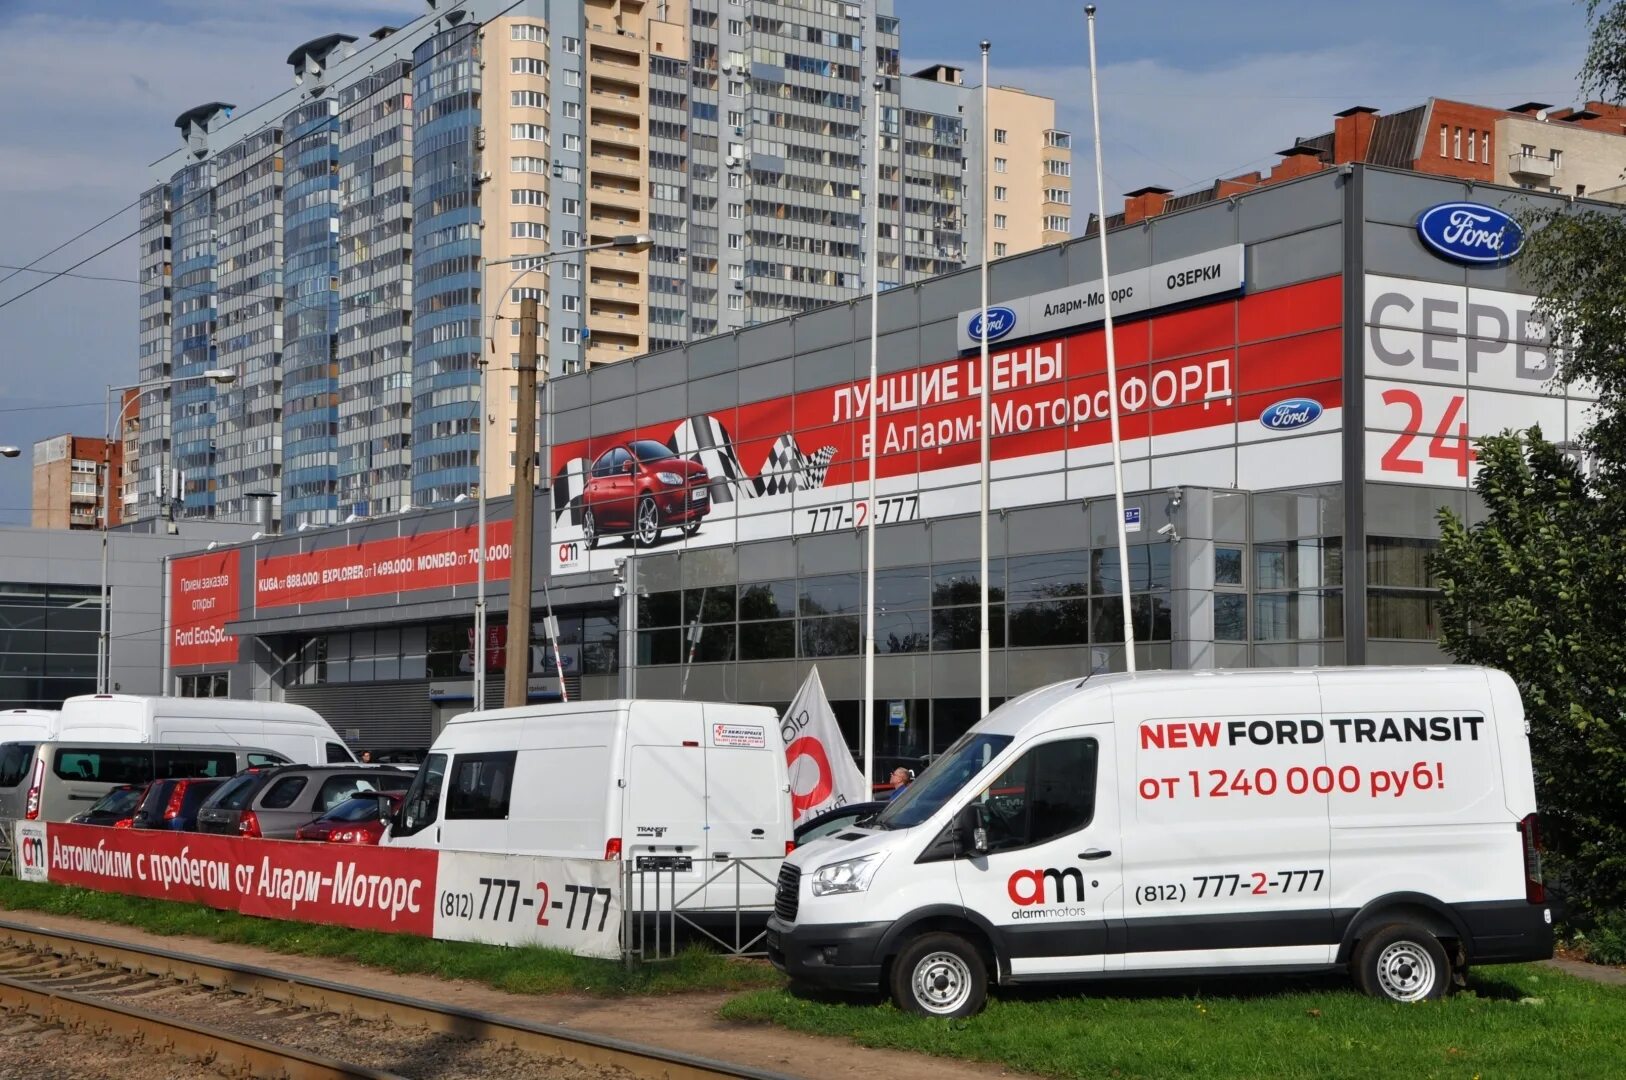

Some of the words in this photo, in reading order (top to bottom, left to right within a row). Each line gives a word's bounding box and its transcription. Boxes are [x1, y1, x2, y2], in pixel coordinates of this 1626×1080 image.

[1443, 209, 1505, 250] Ford
[1044, 286, 1133, 317] Аларм-Моорс
[1166, 263, 1221, 290] ОЗЕРКИ
[975, 312, 1004, 334] Ford
[832, 364, 958, 422] ЛУЧШИЕ
[883, 389, 1109, 454] Аларм-Моторс
[1120, 359, 1232, 412] ФОРД
[1270, 401, 1309, 426] Ford
[1381, 388, 1478, 477] 24
[201, 573, 229, 589] заказов
[258, 578, 279, 593] KUGA
[322, 564, 364, 585] EXPLORER
[417, 551, 457, 571] MONDEO
[192, 596, 215, 611] открыт
[175, 627, 194, 647] Ford
[1139, 722, 1222, 750] NEW
[1227, 719, 1324, 747] FORD
[1330, 716, 1484, 744] TRANSIT
[1139, 777, 1180, 800] от
[1286, 765, 1361, 795] 000
[1370, 761, 1445, 798] руб!
[23, 836, 44, 869] am
[52, 836, 133, 880] Автомобили
[136, 854, 146, 881] с
[150, 846, 229, 892] пробегом
[235, 863, 254, 894] от
[257, 856, 422, 922] Аларм-Моторс
[1007, 866, 1085, 907] am
[1135, 884, 1186, 906] (812)
[1193, 869, 1324, 898] 777-2-777
[440, 889, 474, 921] (812)
[479, 877, 611, 933] 777-2-777
[1011, 905, 1086, 920] alarmmotors
